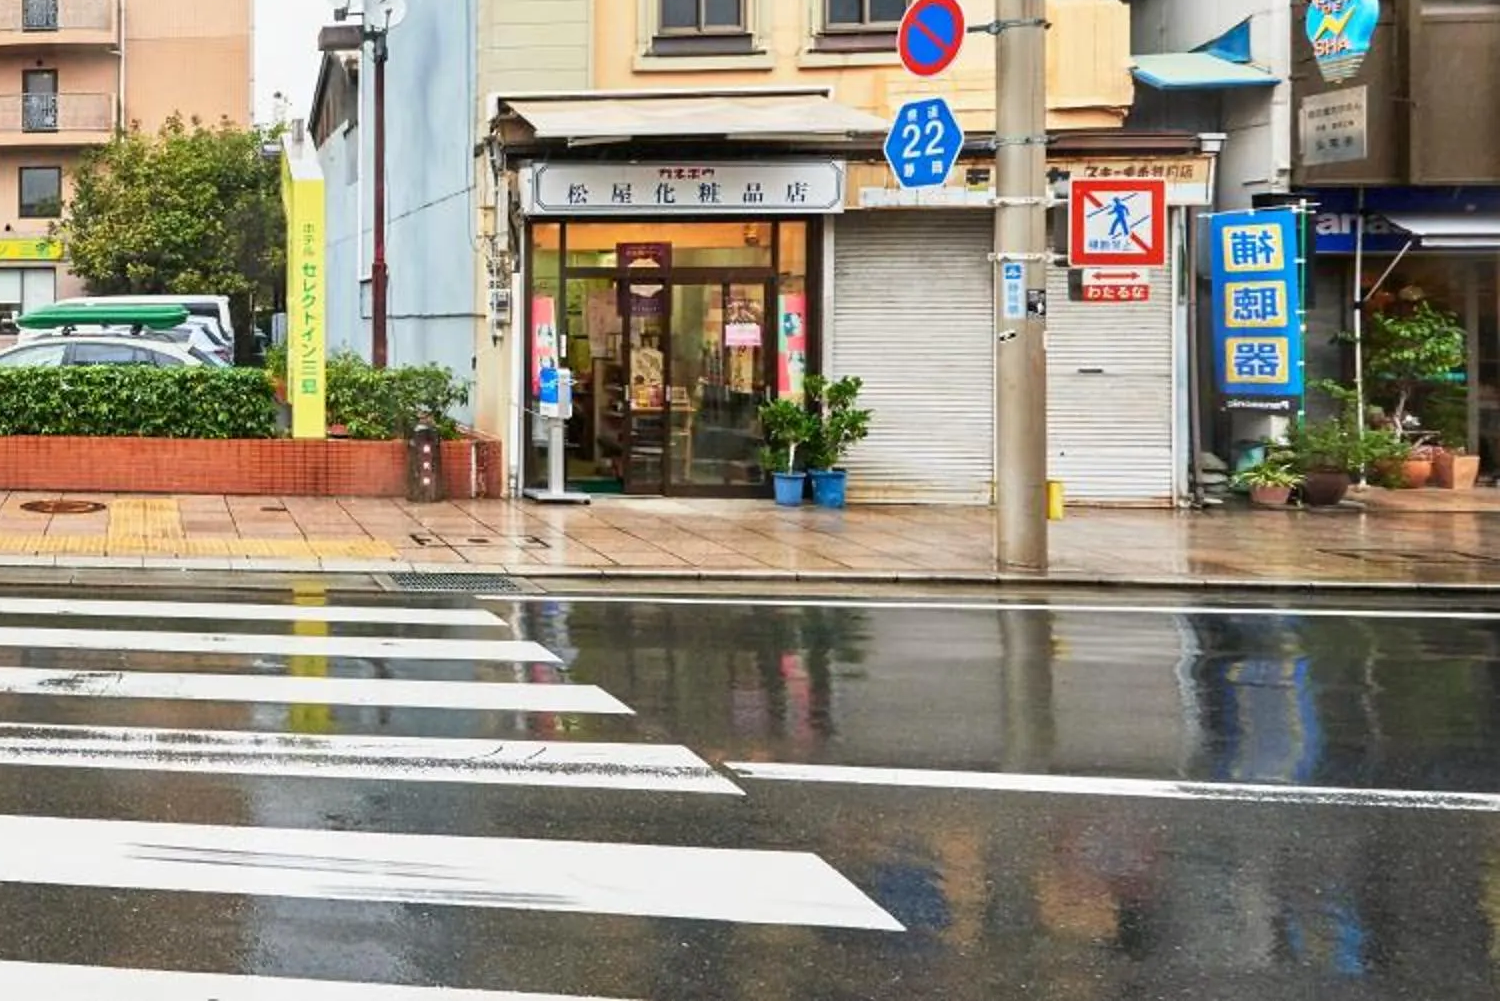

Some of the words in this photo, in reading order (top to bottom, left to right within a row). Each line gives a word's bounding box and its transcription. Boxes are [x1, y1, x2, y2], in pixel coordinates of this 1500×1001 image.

[902, 120, 945, 159] 22
[567, 182, 810, 205] 松屋化粧品店
[1087, 286, 1147, 299] わたるな
